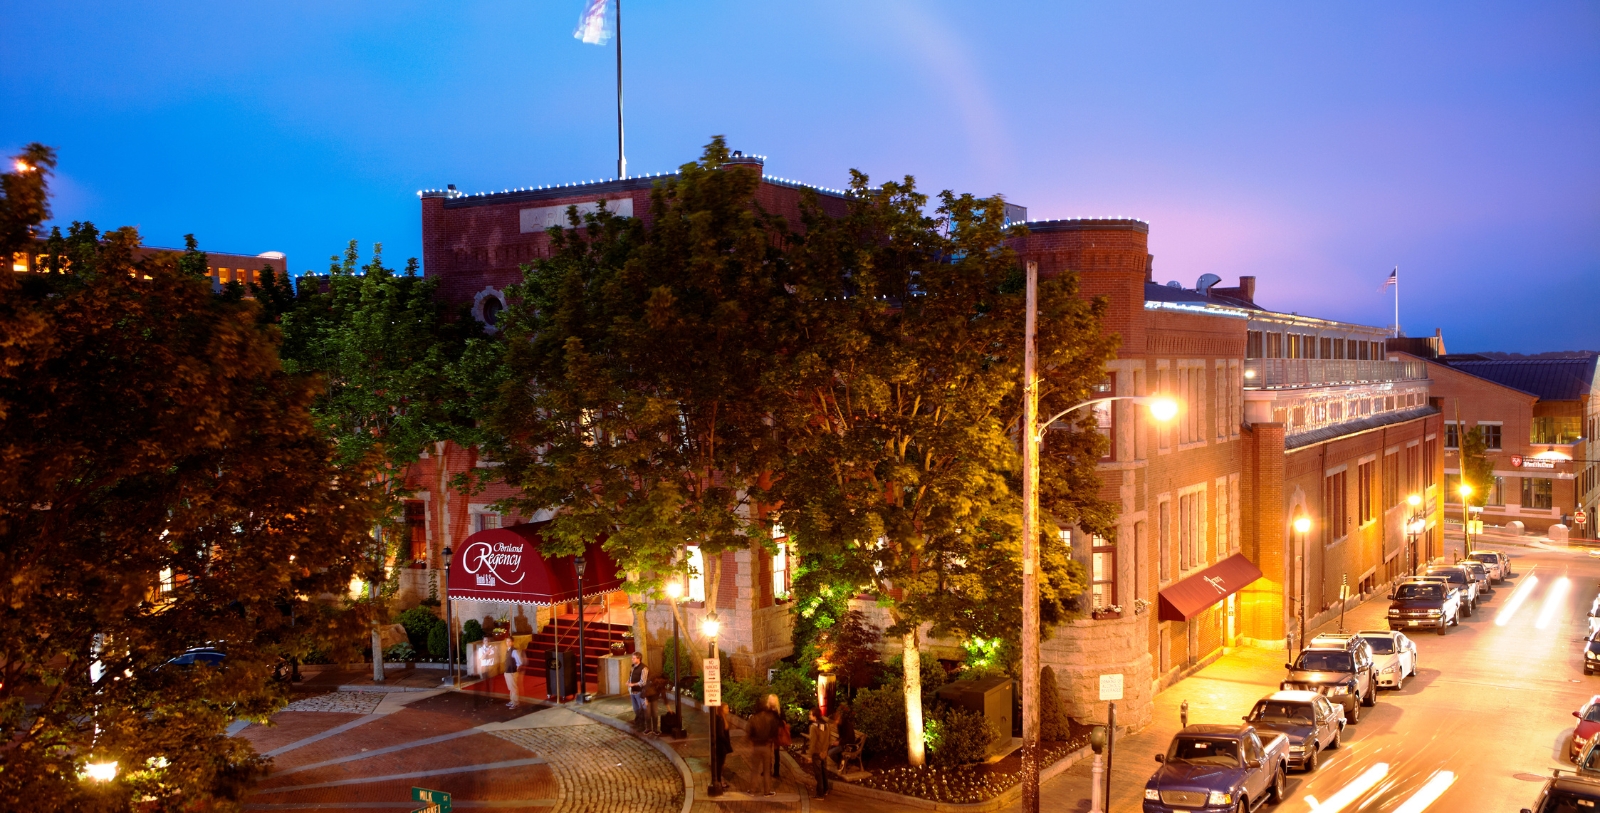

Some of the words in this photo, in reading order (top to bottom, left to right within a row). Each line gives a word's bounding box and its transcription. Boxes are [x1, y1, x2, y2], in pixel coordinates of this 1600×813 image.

[463, 542, 526, 585] Regency
[419, 790, 432, 802] MILK
[418, 804, 440, 813] RKET
